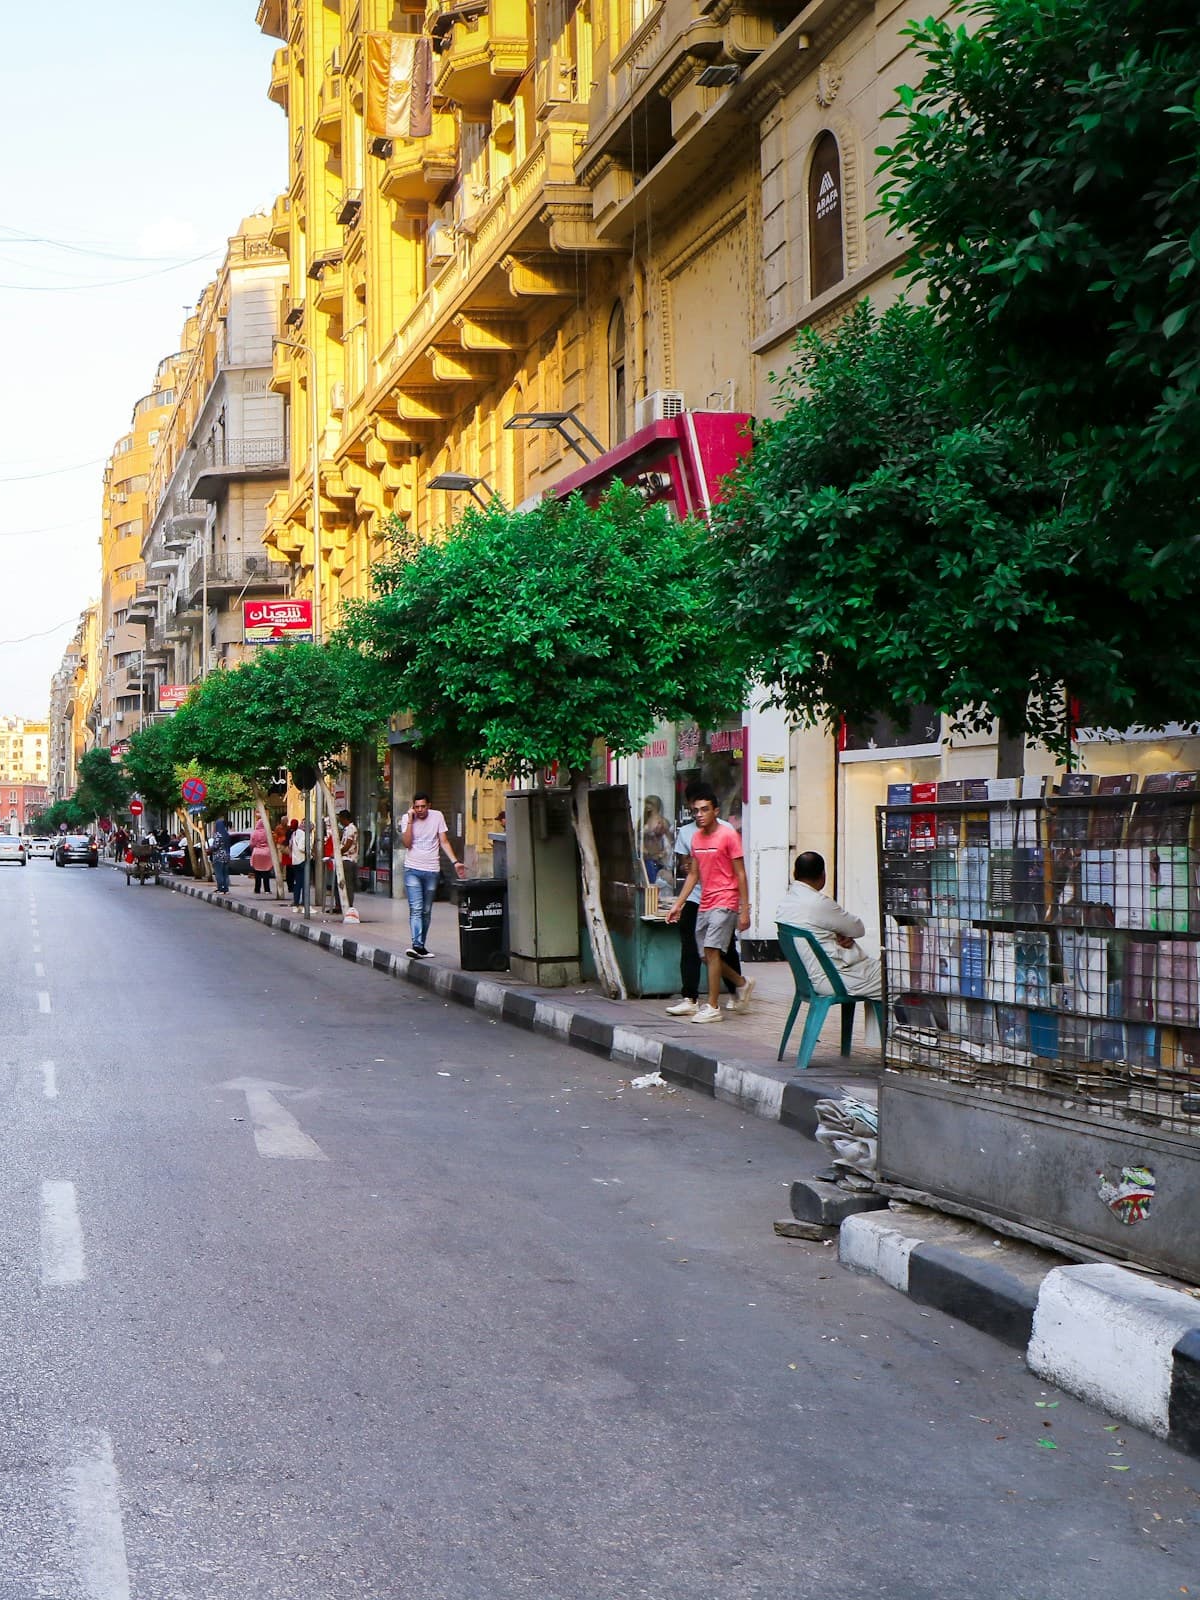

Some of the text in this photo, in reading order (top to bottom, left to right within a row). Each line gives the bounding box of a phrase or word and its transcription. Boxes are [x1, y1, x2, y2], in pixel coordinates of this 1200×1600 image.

[816, 189, 838, 213] ARAFA
[817, 201, 837, 219] GROUP
[250, 605, 301, 621] شعبان
